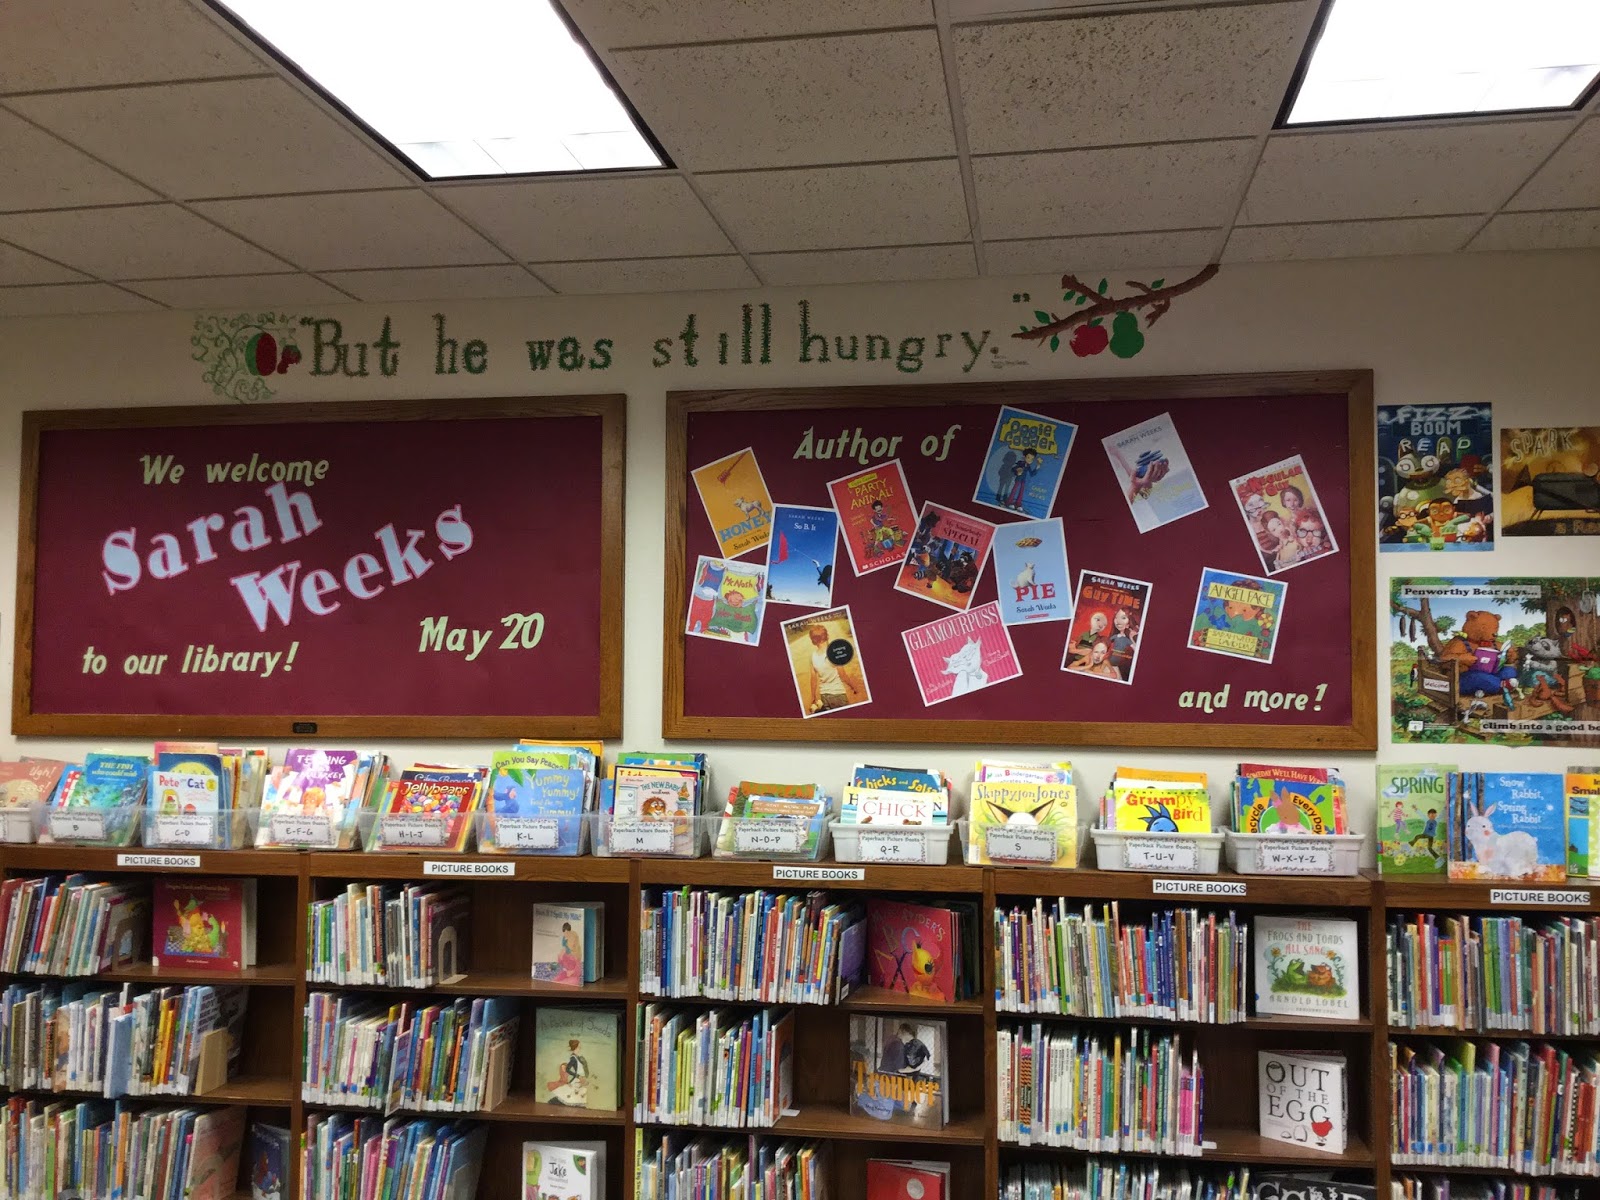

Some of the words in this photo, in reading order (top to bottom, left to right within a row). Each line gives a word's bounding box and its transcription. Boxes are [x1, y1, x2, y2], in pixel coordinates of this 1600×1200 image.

[432, 312, 489, 375] he
[525, 335, 614, 372] was
[652, 303, 773, 370] still
[1410, 420, 1462, 436] BOOM
[1117, 435, 1140, 448] SARAH
[1139, 425, 1163, 440] WEEKS
[793, 425, 901, 465] Author
[920, 425, 962, 463] of
[1510, 428, 1577, 463] SPARK
[139, 453, 185, 485] We
[205, 453, 330, 487] welcome
[855, 478, 888, 497] PARTY
[793, 522, 803, 531] So
[810, 523, 817, 531] It
[101, 481, 323, 596] Sarah
[733, 538, 752, 551] Sarah
[942, 527, 980, 547] SPECIAL
[230, 504, 475, 632] Weeks
[1091, 576, 1116, 586] SARAH
[1117, 580, 1141, 591] WEEKS
[1015, 583, 1057, 602] PIE
[1083, 585, 1110, 603] GUY
[1110, 591, 1141, 610] TIME
[1210, 583, 1246, 602] ANGEL
[1246, 590, 1273, 606] FACE
[1404, 587, 1469, 598] Penworthy
[1472, 588, 1501, 597] Bear
[1016, 605, 1036, 614] Sarah
[1036, 603, 1058, 613] Weeks
[908, 606, 1000, 651] GLAMOURPUSS
[418, 615, 495, 662] May
[499, 613, 546, 651] 20
[82, 645, 108, 676] to
[123, 652, 168, 676] our
[181, 641, 300, 678] library!
[1178, 683, 1231, 714] and
[1243, 683, 1329, 713] more!
[1482, 721, 1518, 731] climb
[1518, 722, 1543, 731] into
[1545, 723, 1553, 731] a
[1555, 722, 1585, 733] good
[100, 761, 116, 769] THE
[495, 760, 510, 770] Can
[511, 756, 525, 765] You
[526, 756, 540, 766] Say
[29, 766, 57, 780] Ugh!
[1291, 770, 1308, 781] HAVE
[159, 774, 180, 788] Pete
[187, 778, 205, 790] Cat
[400, 781, 470, 796] Jellybeans
[525, 773, 570, 790] Yummy
[651, 781, 667, 789] NEW
[1391, 776, 1444, 794] SPRING
[1499, 776, 1526, 788] Snow
[541, 787, 580, 801] Yummy!
[1032, 785, 1072, 803] Jones
[1125, 793, 1196, 808] Grumpy
[1511, 788, 1545, 801] Rabbit,
[862, 801, 927, 818] CHICK
[1173, 807, 1204, 822] Bird
[1291, 795, 1317, 819] Every
[1497, 800, 1527, 816] Spring
[1250, 803, 1265, 834] ecycle
[1511, 812, 1542, 824] Rabbit
[174, 829, 191, 837] C-D
[285, 827, 313, 836] E-F-G
[398, 830, 424, 838] H-I-J
[516, 832, 534, 841] K-L
[751, 836, 781, 844] N-O-P
[1014, 842, 1022, 851] S
[880, 845, 900, 854] Q-R
[1143, 852, 1175, 861] T-U-V
[124, 856, 162, 865] PICTURE
[163, 857, 196, 866] BOOKS
[1271, 854, 1317, 863] W-X-Y-Z
[431, 864, 472, 873] PICTURE
[474, 865, 509, 874] BOOKS
[775, 869, 820, 878] PICTURE
[821, 870, 858, 879] BOOKS
[1155, 882, 1204, 893] PICTURE
[1206, 884, 1247, 894] BOOKS
[1492, 892, 1544, 902] PICTURE
[1546, 893, 1590, 903] BOOKS
[1296, 920, 1312, 932] THE
[1267, 930, 1294, 942] FROGS
[1296, 932, 1313, 943] AND
[1315, 933, 1344, 945] TOADS
[1285, 943, 1301, 955] ALL
[1304, 944, 1326, 956] SANG
[1269, 994, 1312, 1005] ARNOLD
[1316, 998, 1349, 1008] LOBEL
[1266, 1060, 1330, 1092] OUT
[852, 1060, 940, 1113] Trouper
[1266, 1082, 1287, 1096] OF
[1296, 1088, 1330, 1105] THE
[1267, 1094, 1331, 1124] EGG
[548, 1162, 568, 1178] Jake
